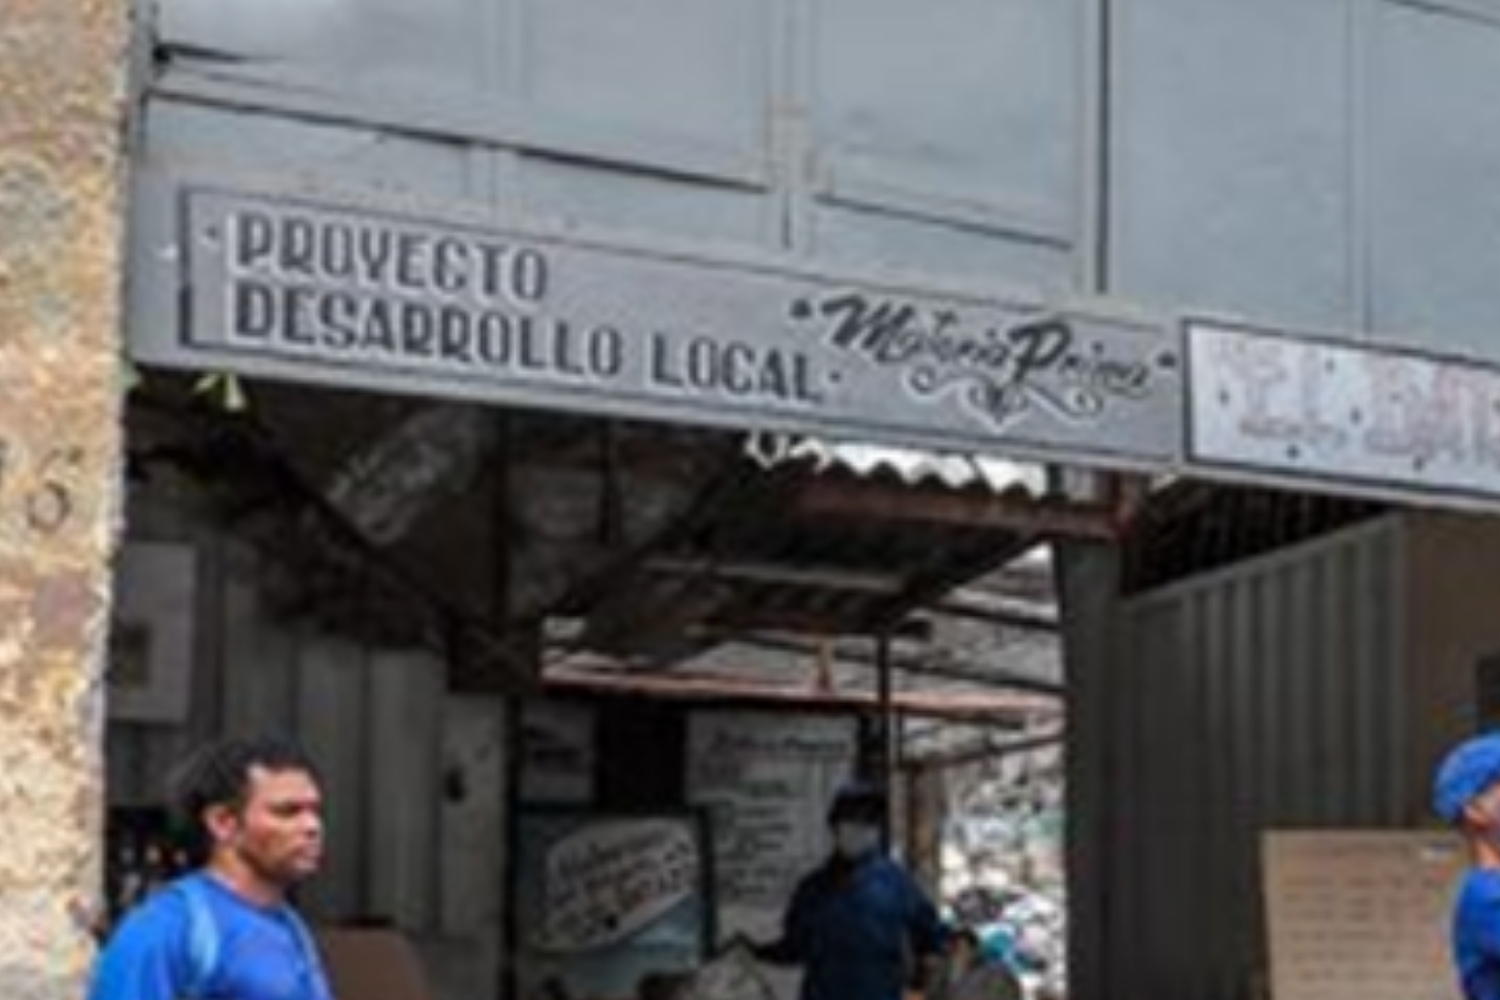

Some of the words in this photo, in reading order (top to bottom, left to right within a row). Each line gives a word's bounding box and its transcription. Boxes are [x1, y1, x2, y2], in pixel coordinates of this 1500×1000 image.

[236, 212, 548, 301] PROYECTO
[236, 281, 622, 377] DESARROLLO
[651, 333, 822, 402] LOCAL
